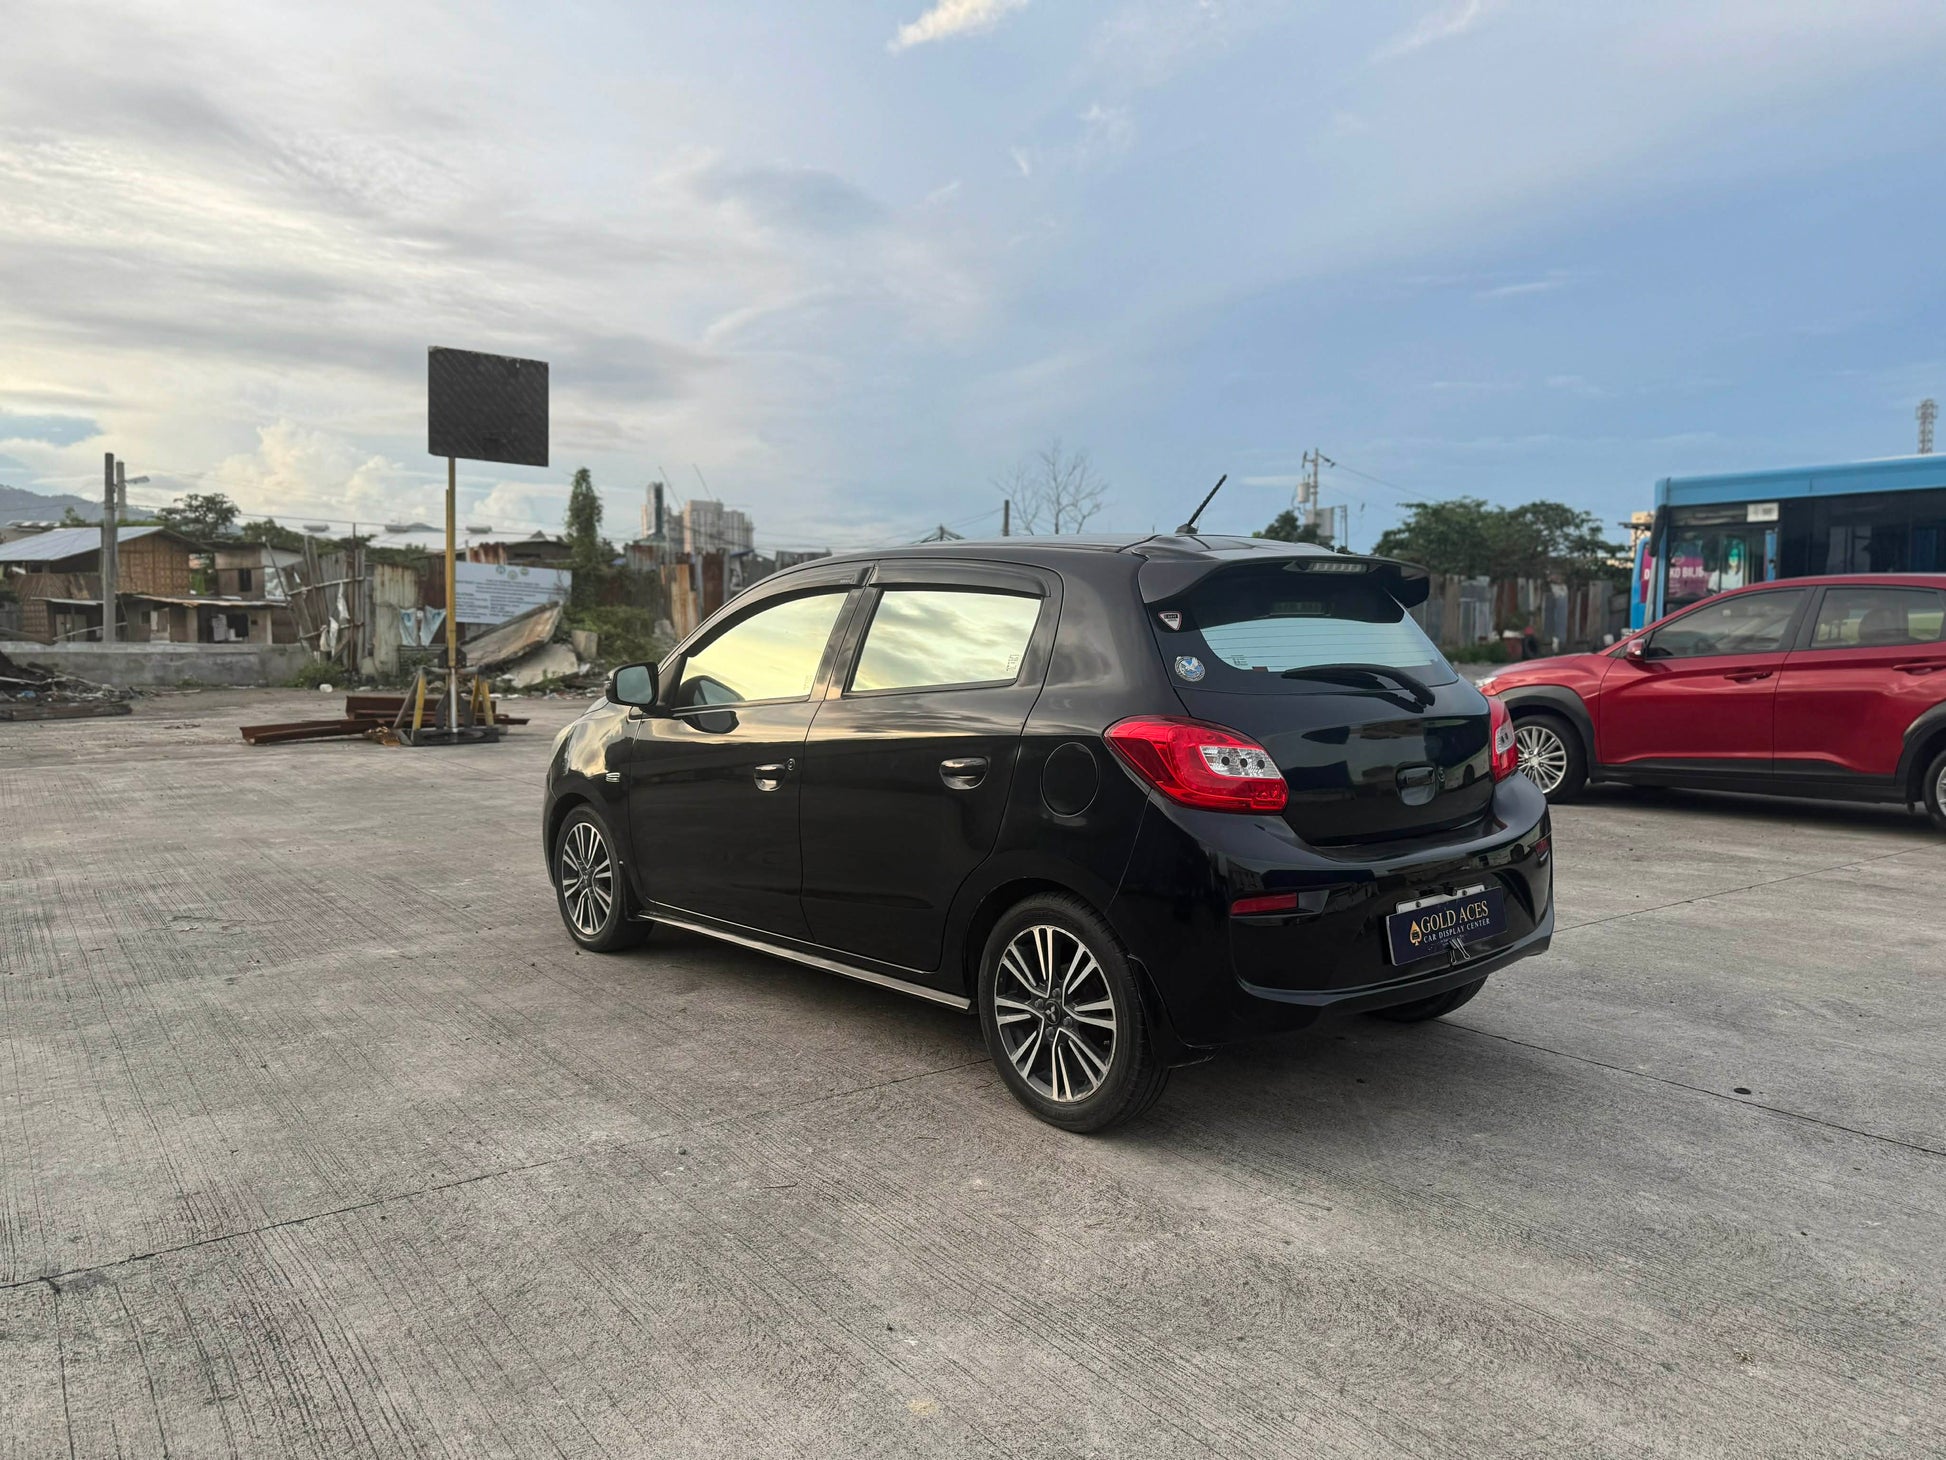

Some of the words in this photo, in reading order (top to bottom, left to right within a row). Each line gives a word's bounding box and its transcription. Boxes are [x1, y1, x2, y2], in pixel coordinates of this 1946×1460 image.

[1420, 910, 1456, 934] GOLD
[1459, 901, 1489, 924] ACES
[1423, 933, 1437, 943] CAR
[1438, 925, 1465, 939] DISPLAY
[1466, 918, 1491, 930] CENTER
